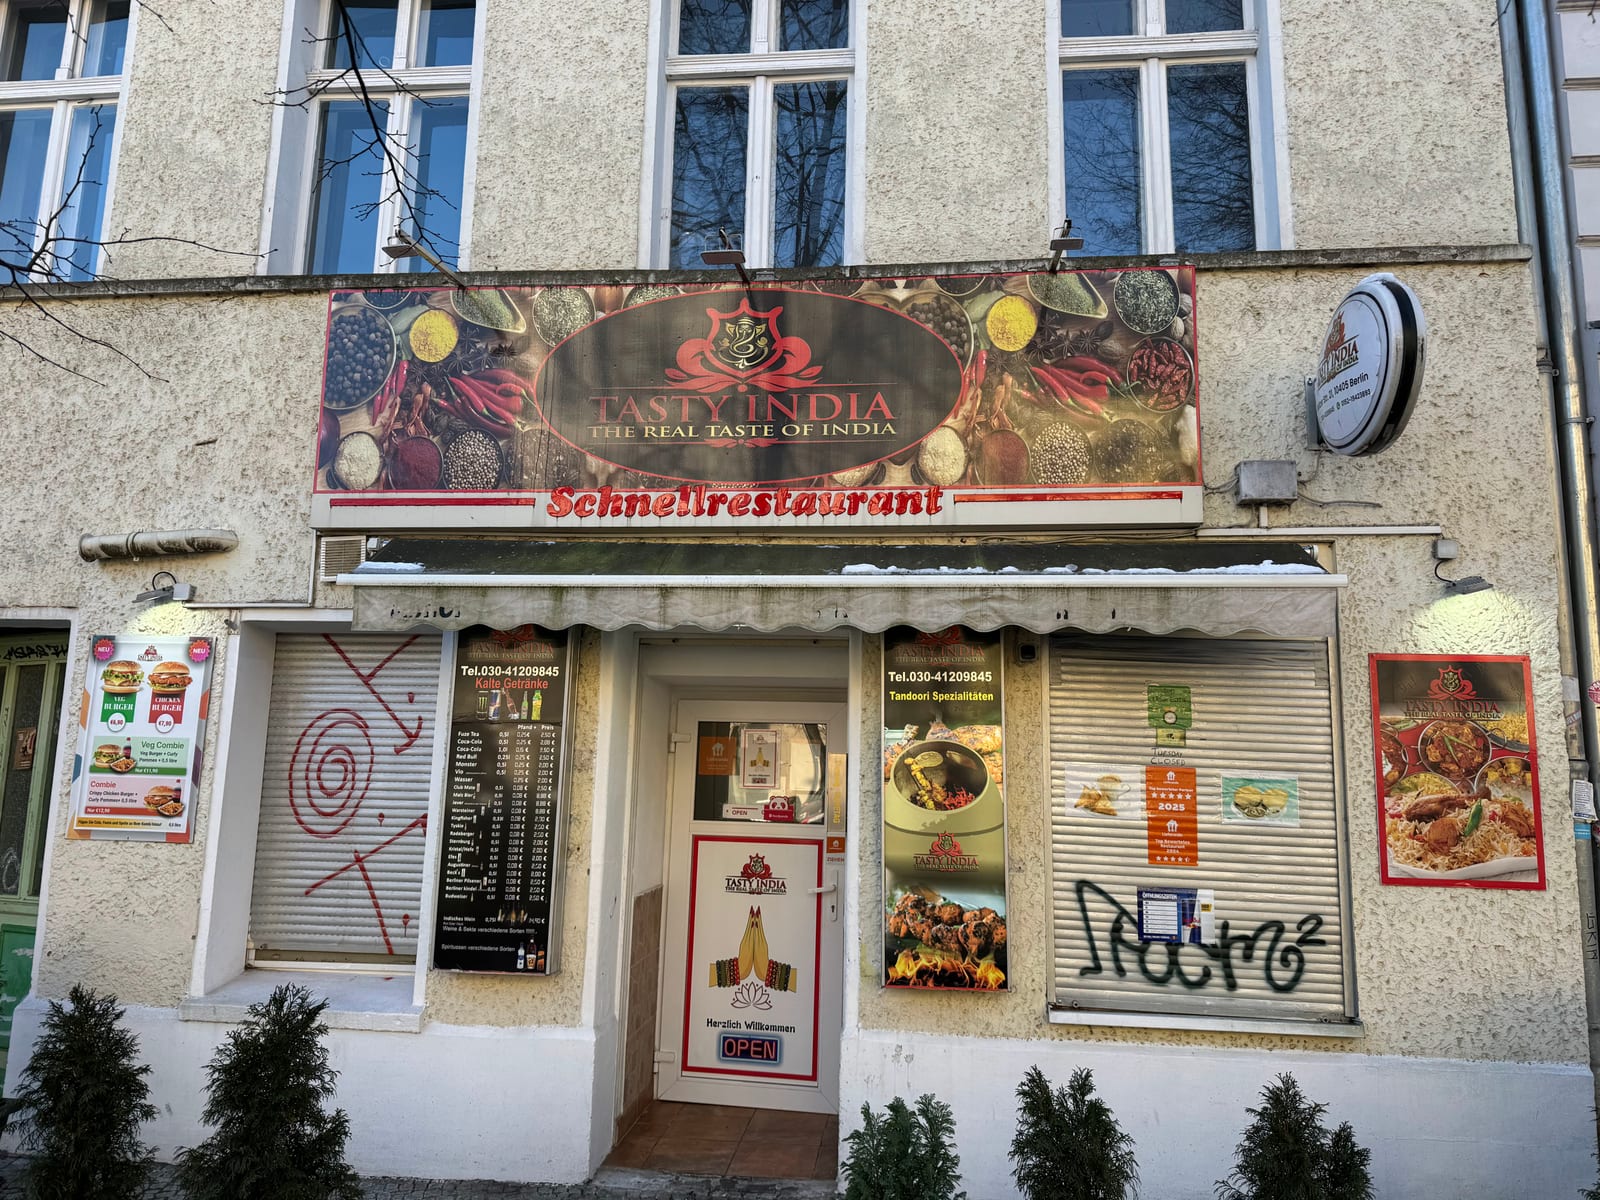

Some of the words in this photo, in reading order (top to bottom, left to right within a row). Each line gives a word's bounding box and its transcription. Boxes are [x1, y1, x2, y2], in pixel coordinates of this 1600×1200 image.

[1334, 380, 1349, 395] 10405
[1350, 372, 1369, 388] Berlin
[590, 394, 732, 424] TASTY
[746, 391, 896, 423] INDIA
[587, 425, 636, 439] THE
[644, 424, 700, 439] REAL
[705, 424, 775, 439] TASTE
[782, 423, 816, 437] OF
[822, 422, 897, 436] INDIA
[546, 484, 944, 518] Schnellrestaurant
[513, 642, 554, 654] INDIA
[896, 645, 936, 657] TASTY
[942, 645, 985, 657] INDIA
[460, 666, 559, 677] Tel.030-41209845
[888, 671, 993, 682] Tel.030-41209845
[476, 677, 501, 689] Kalte
[504, 677, 549, 689] Getränke
[889, 691, 930, 701] Tandoori
[932, 691, 994, 703] Spezialitäten
[152, 704, 182, 712] BURGER
[1405, 700, 1447, 712] TASTY
[1453, 701, 1501, 713] INDIA
[142, 741, 155, 750] Veg
[156, 742, 185, 750] Combie
[1151, 758, 1186, 766] CLOSED
[1158, 803, 1186, 812] 2025
[913, 856, 945, 865] TASTY
[947, 856, 979, 865] INDIA
[725, 878, 754, 888] TASTY
[757, 880, 787, 889] INDIA
[706, 1018, 742, 1029] Herzlich
[745, 1020, 796, 1033] Willkommen
[724, 1038, 776, 1059] OPEN
